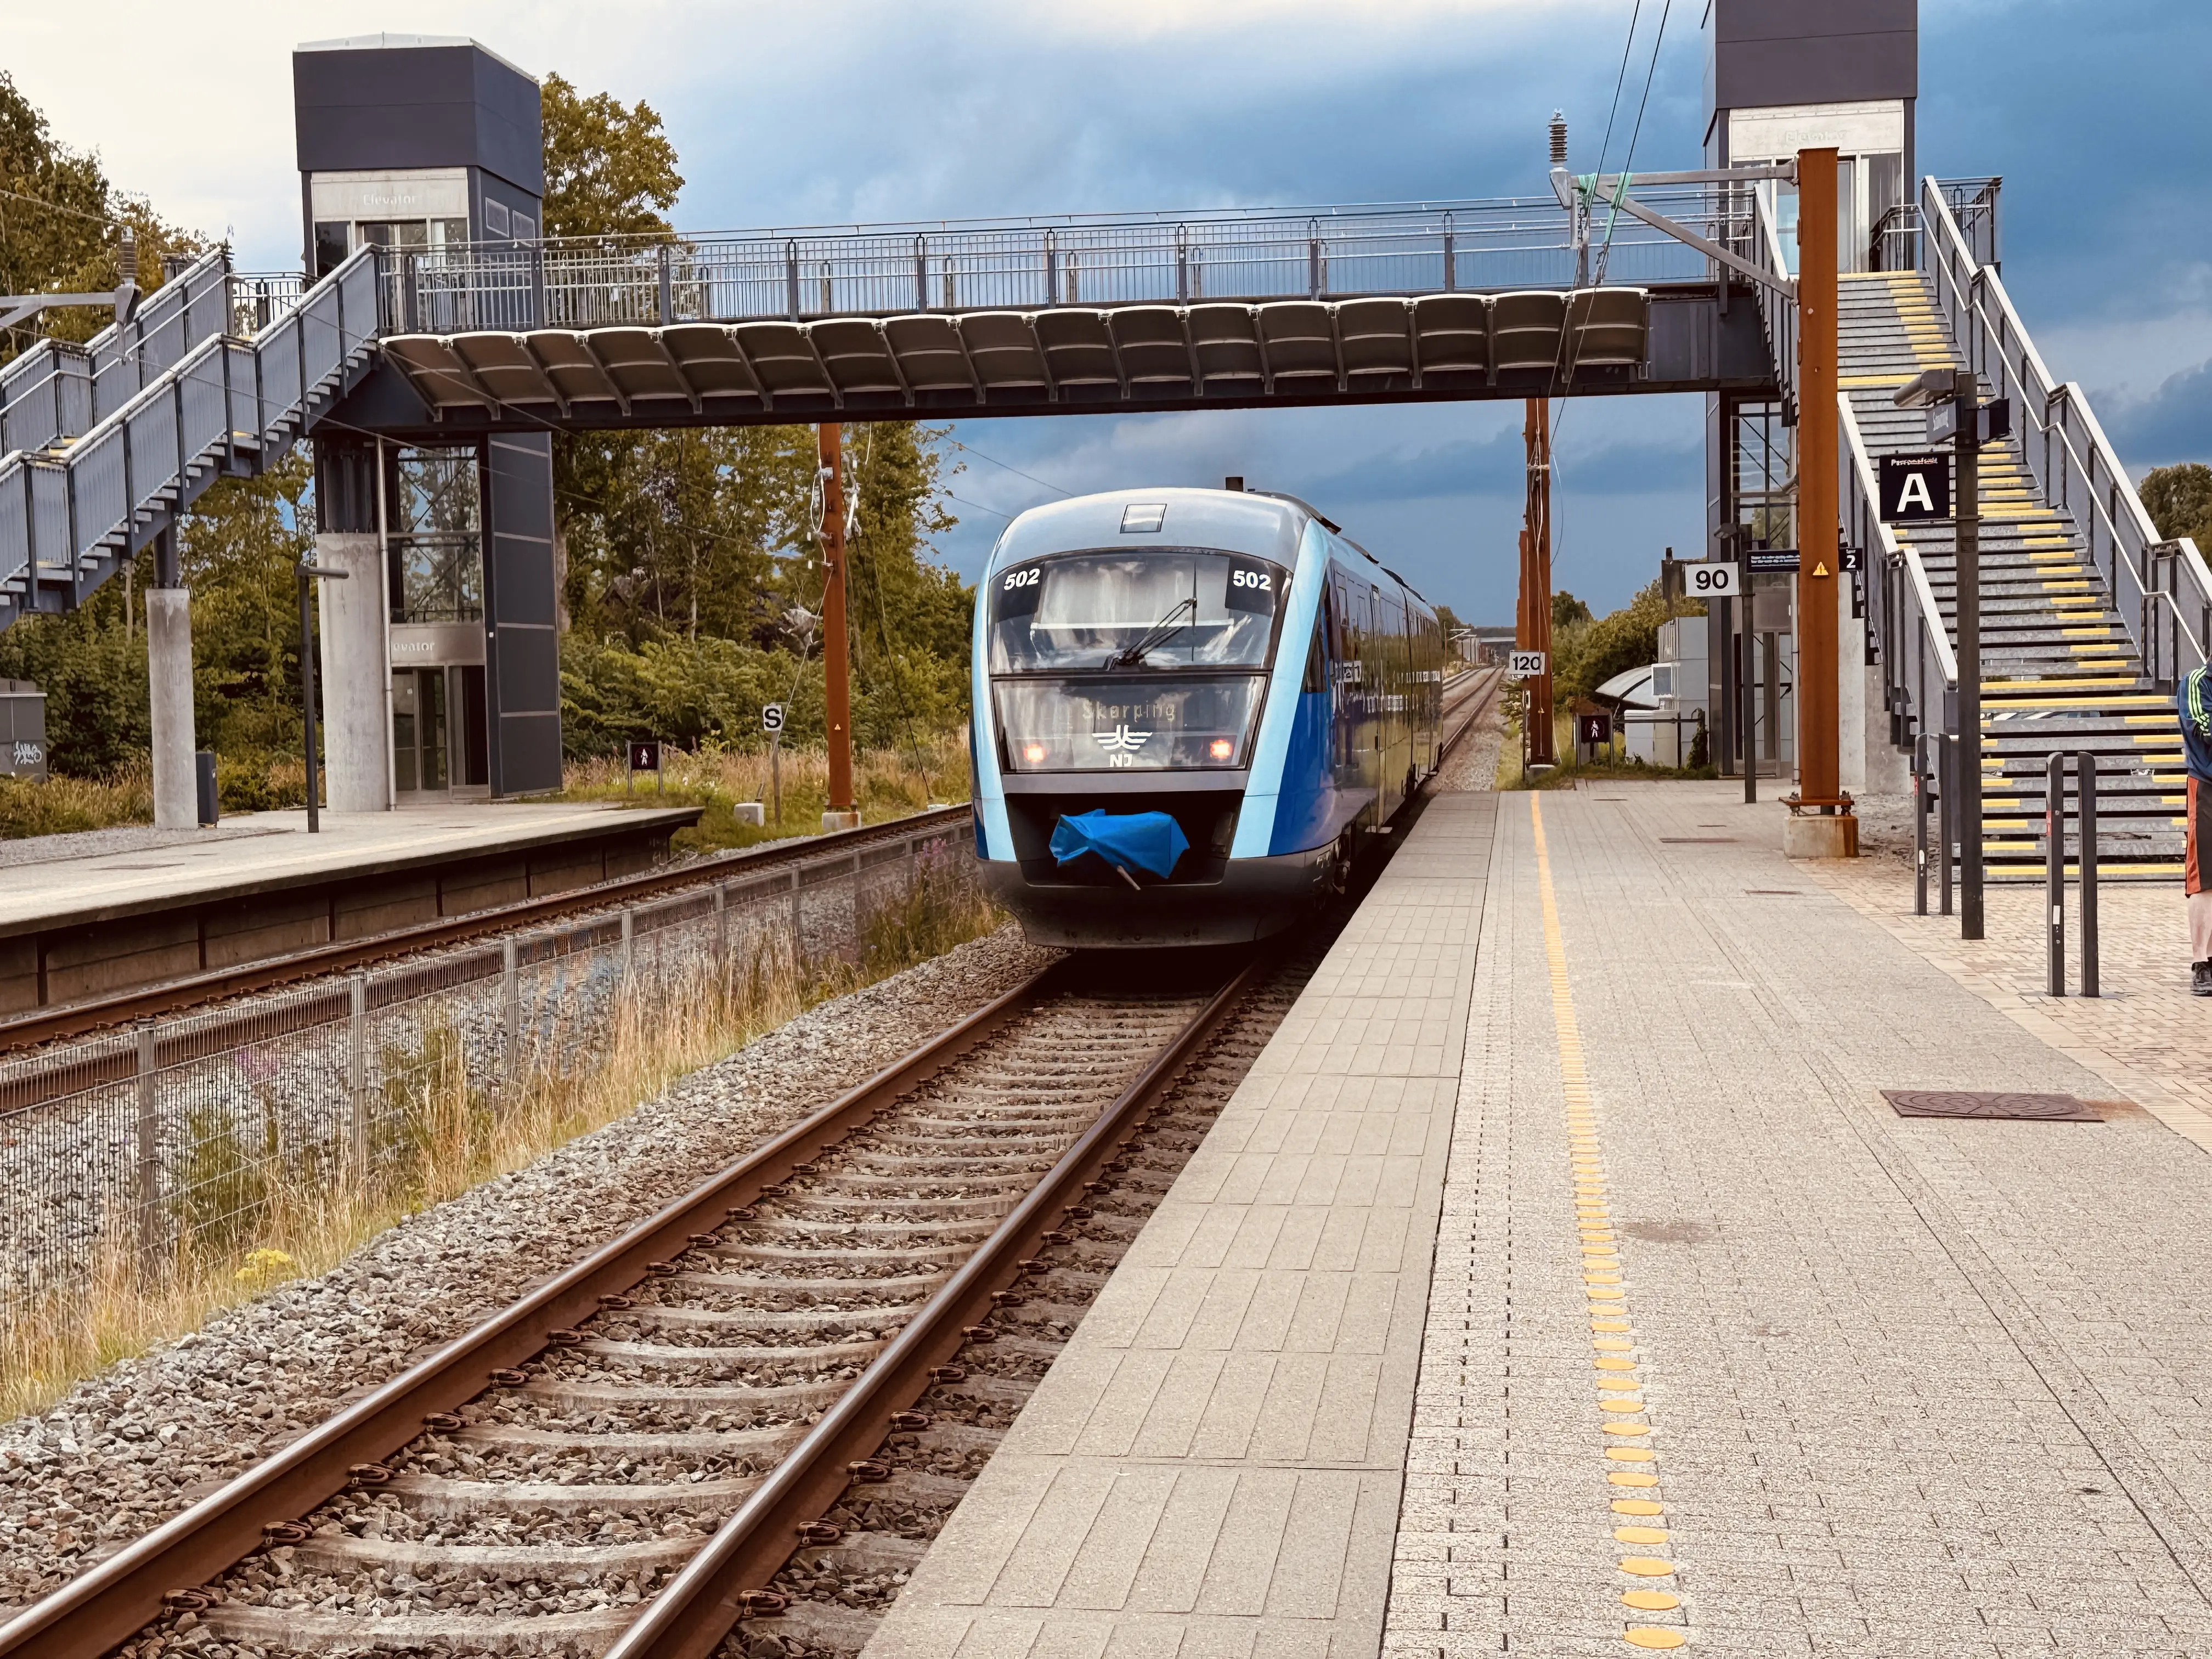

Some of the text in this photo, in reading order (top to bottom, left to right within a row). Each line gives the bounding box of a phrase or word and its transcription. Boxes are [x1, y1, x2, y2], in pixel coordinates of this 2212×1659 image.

[1897, 472, 1934, 512] A
[1846, 555, 1856, 568] 2
[1003, 568, 1041, 590] 502
[1233, 570, 1272, 591] 502
[1695, 569, 1729, 590] 90
[393, 642, 435, 652] evator
[1513, 656, 1542, 670] 120
[764, 708, 782, 729] S
[1109, 754, 1133, 768] NJ
